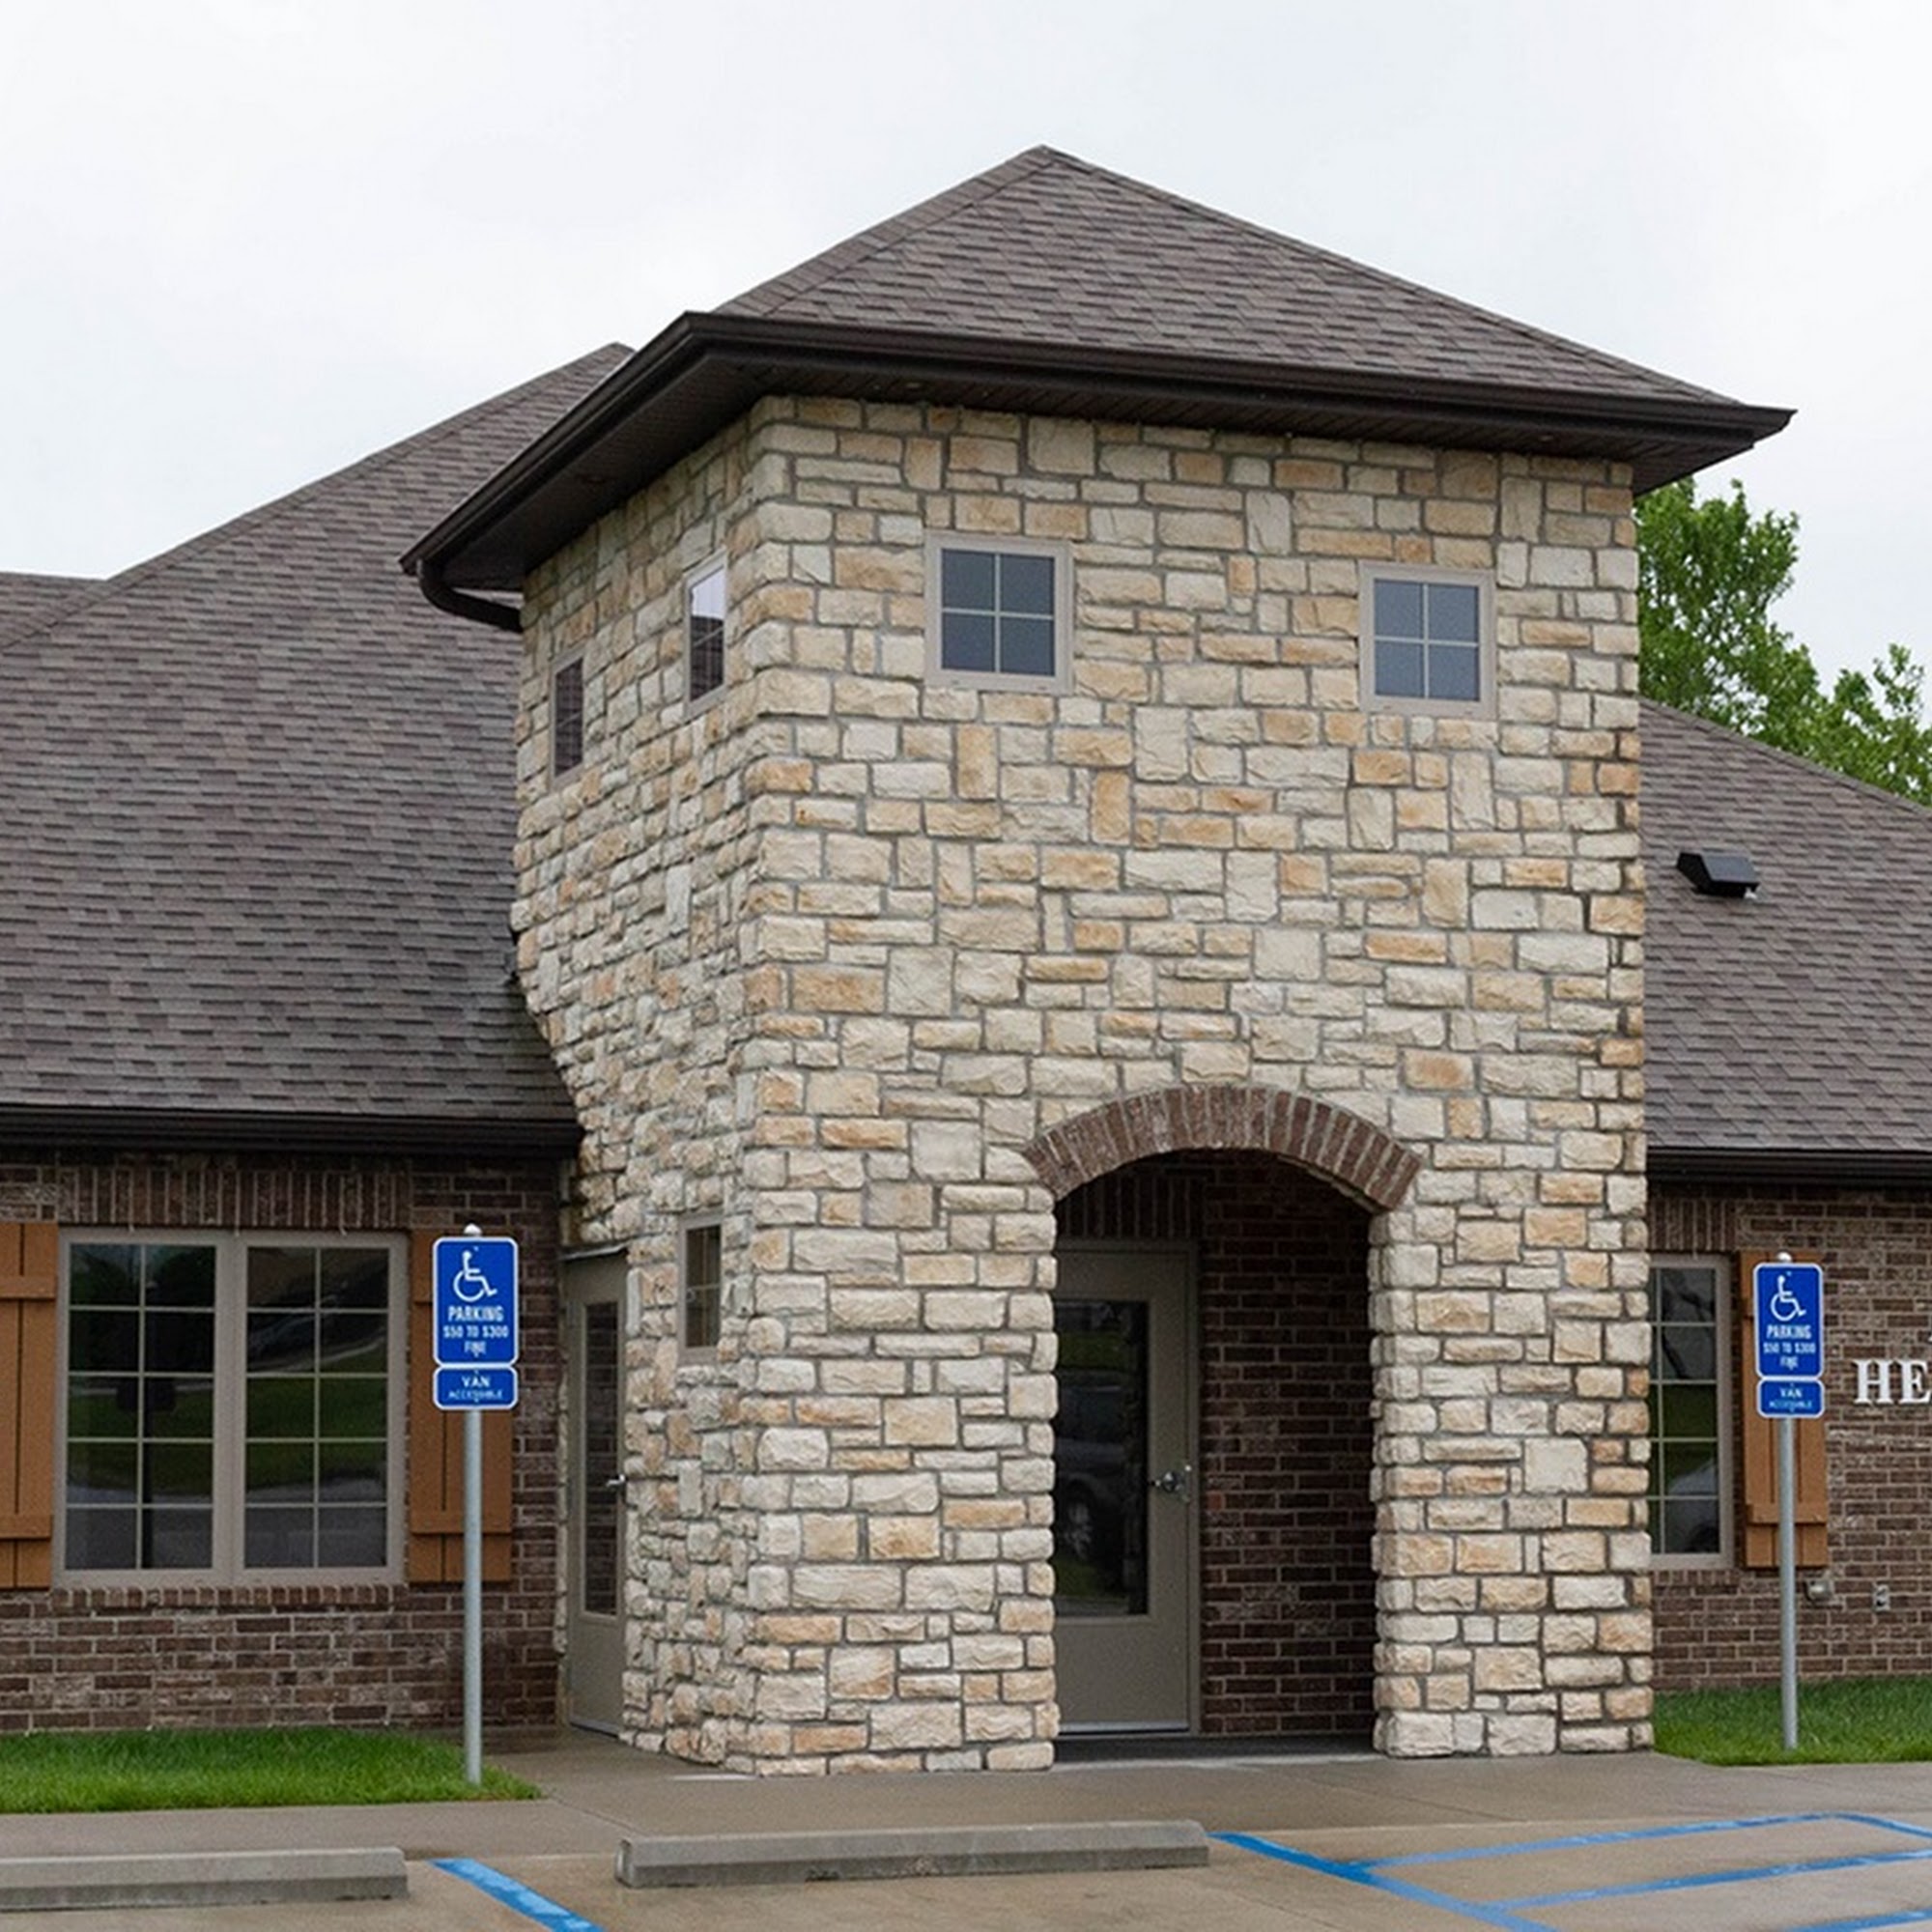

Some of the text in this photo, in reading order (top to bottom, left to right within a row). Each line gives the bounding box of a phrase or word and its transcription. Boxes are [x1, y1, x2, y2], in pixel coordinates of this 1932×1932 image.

[448, 1306, 503, 1321] PARKING
[443, 1325, 509, 1338] $50 TO $300
[1767, 1325, 1812, 1339] PARKING
[1782, 1342, 1792, 1354] TO
[462, 1376, 491, 1387] VAN
[1780, 1388, 1803, 1398] VAN
